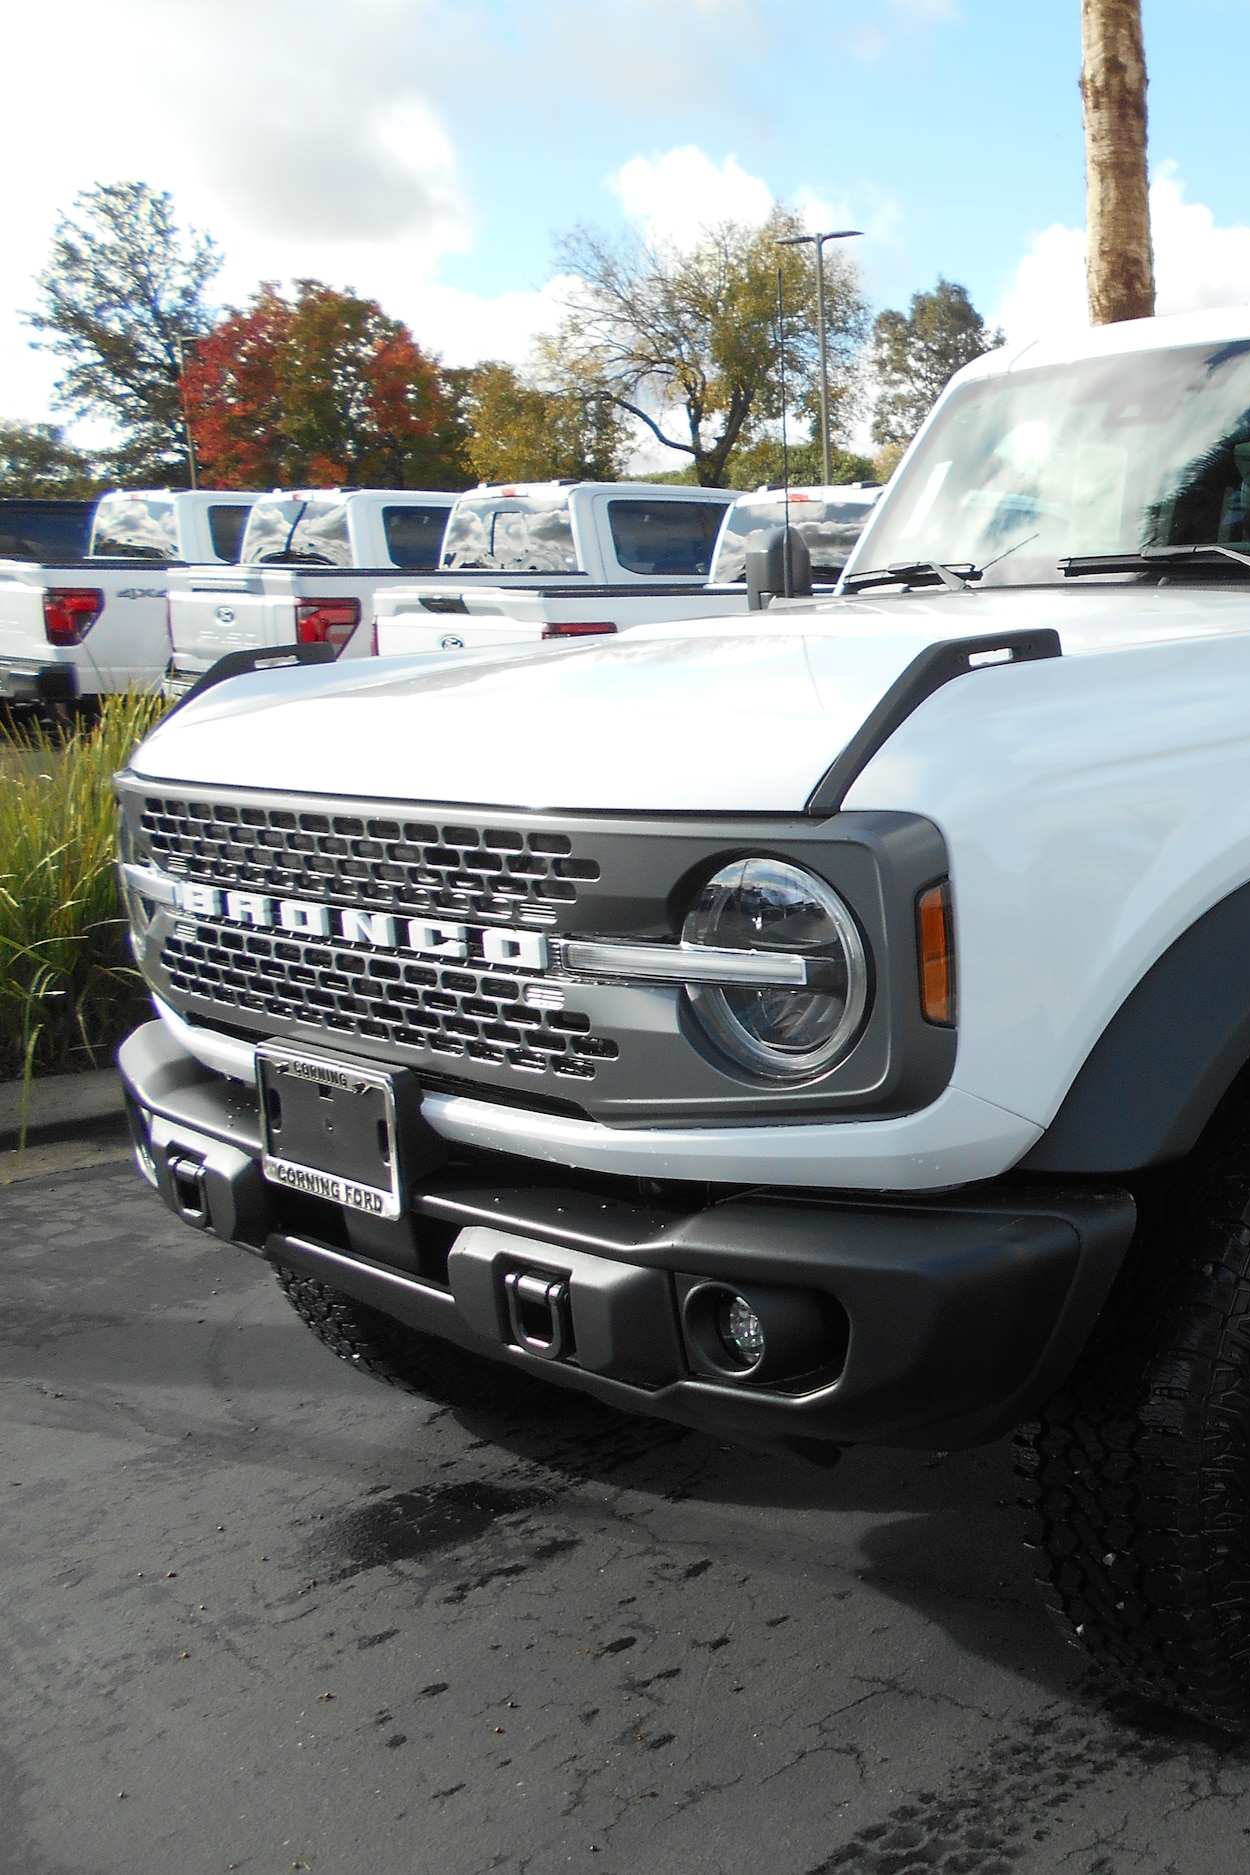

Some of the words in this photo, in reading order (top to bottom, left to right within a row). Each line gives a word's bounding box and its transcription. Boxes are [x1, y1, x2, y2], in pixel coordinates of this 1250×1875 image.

[182, 882, 549, 970] BRONCO
[293, 1060, 348, 1088] CORNING
[277, 1164, 340, 1200] CORNING
[344, 1183, 383, 1214] FORD
